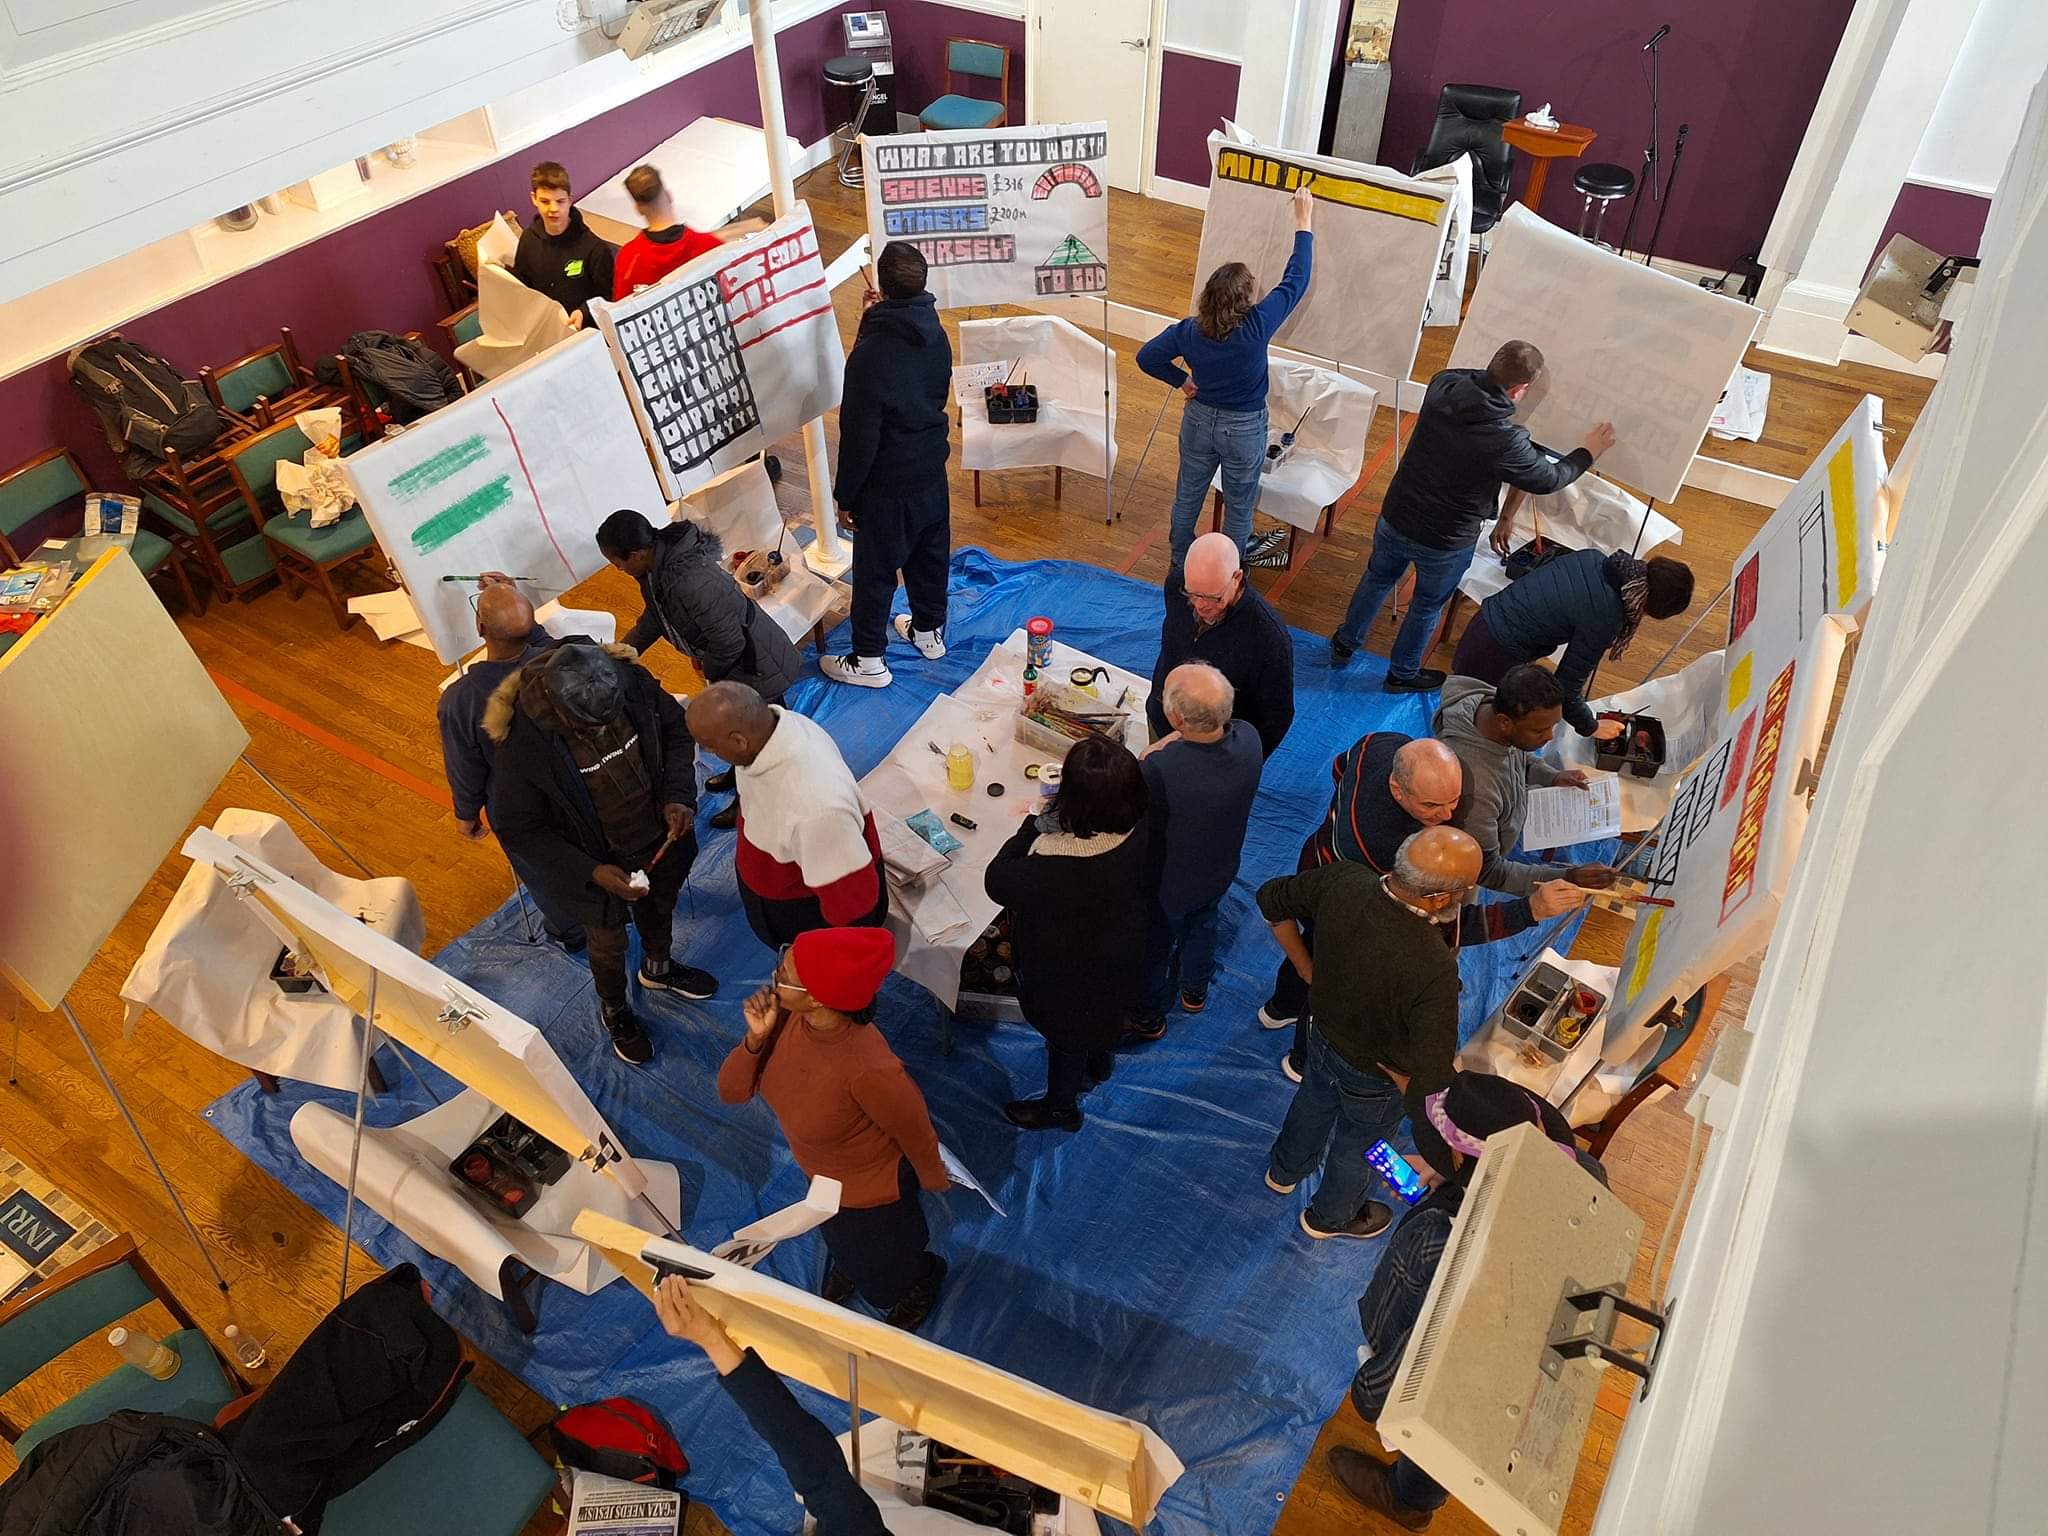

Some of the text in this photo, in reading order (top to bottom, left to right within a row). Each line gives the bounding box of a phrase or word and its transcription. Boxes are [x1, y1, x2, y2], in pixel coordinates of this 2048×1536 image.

[879, 136, 1104, 170] WHAT ARE YOU WORTH
[884, 177, 986, 202] SCIENCE
[886, 207, 986, 233] OTHERS
[918, 237, 1014, 264] URSELF
[0, 1203, 59, 1252] INRI
[614, 1503, 645, 1519] NEEDS
